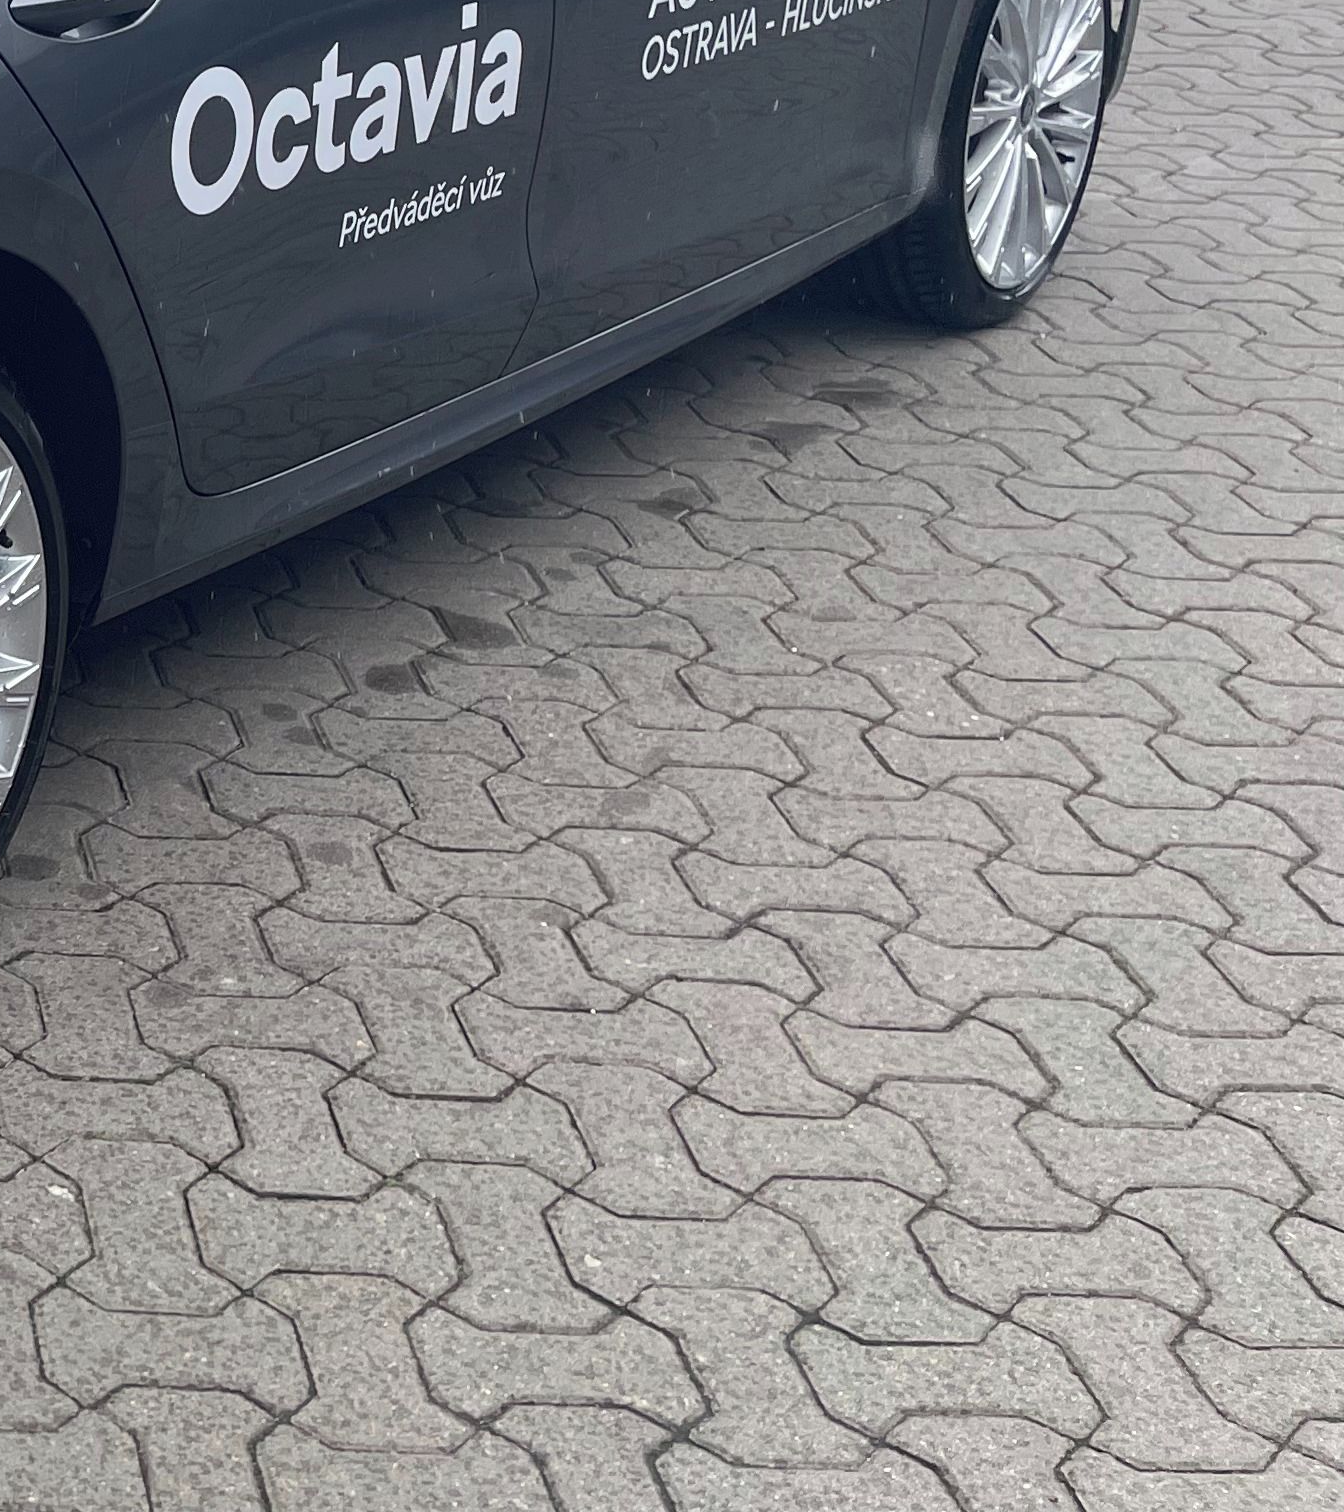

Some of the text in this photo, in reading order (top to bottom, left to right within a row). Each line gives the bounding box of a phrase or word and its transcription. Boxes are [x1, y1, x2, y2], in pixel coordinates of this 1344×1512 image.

[641, 6, 758, 81] OSTRAVA
[170, 1, 524, 217] Octavia
[338, 165, 506, 248] Předváděcí vůz
